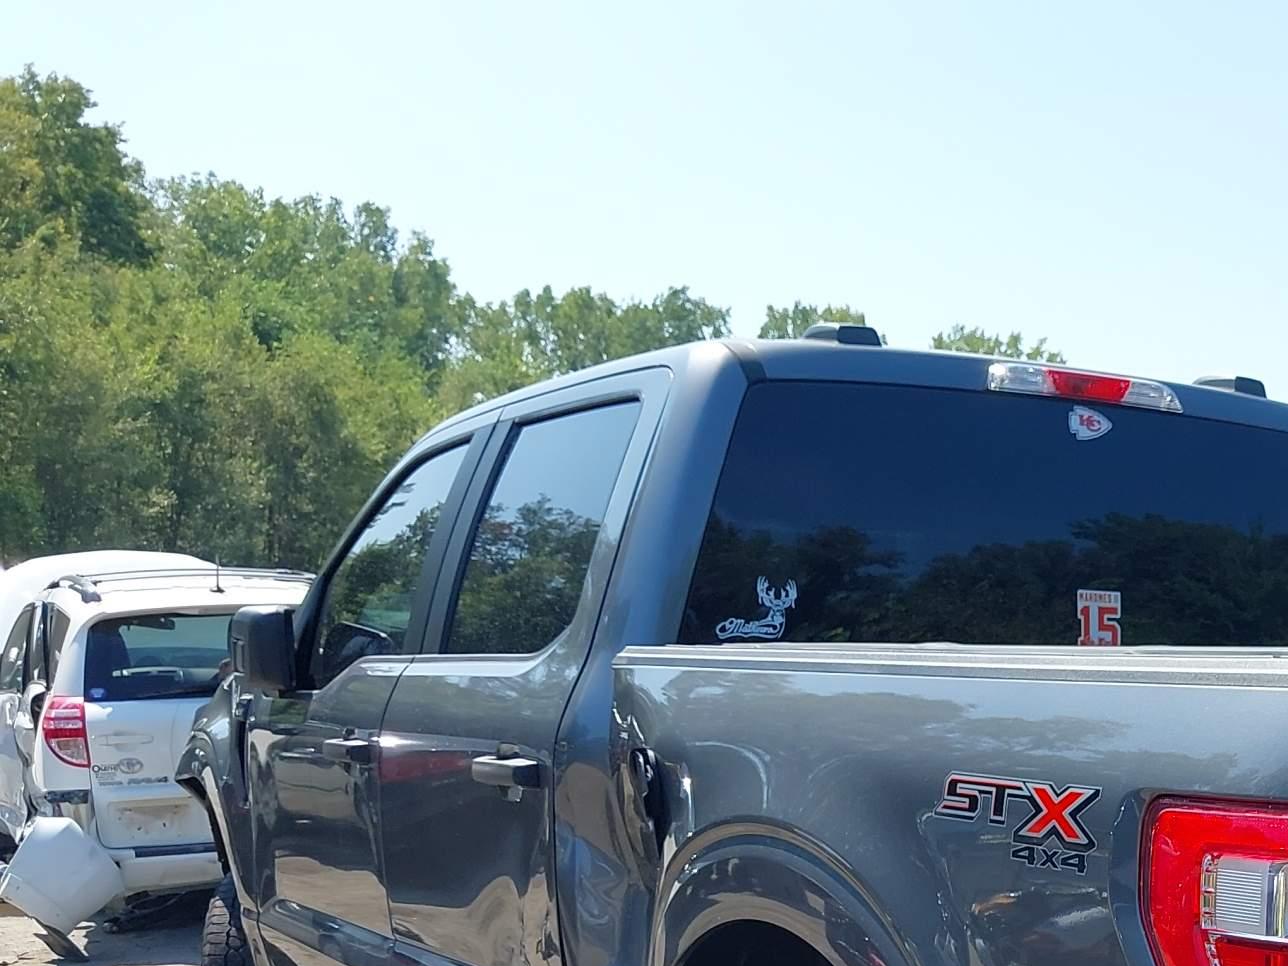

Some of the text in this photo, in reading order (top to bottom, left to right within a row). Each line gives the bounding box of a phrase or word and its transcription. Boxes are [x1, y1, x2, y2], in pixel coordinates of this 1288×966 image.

[1081, 606, 1118, 646] 15
[128, 776, 168, 785] R4
[933, 771, 1102, 854] STX
